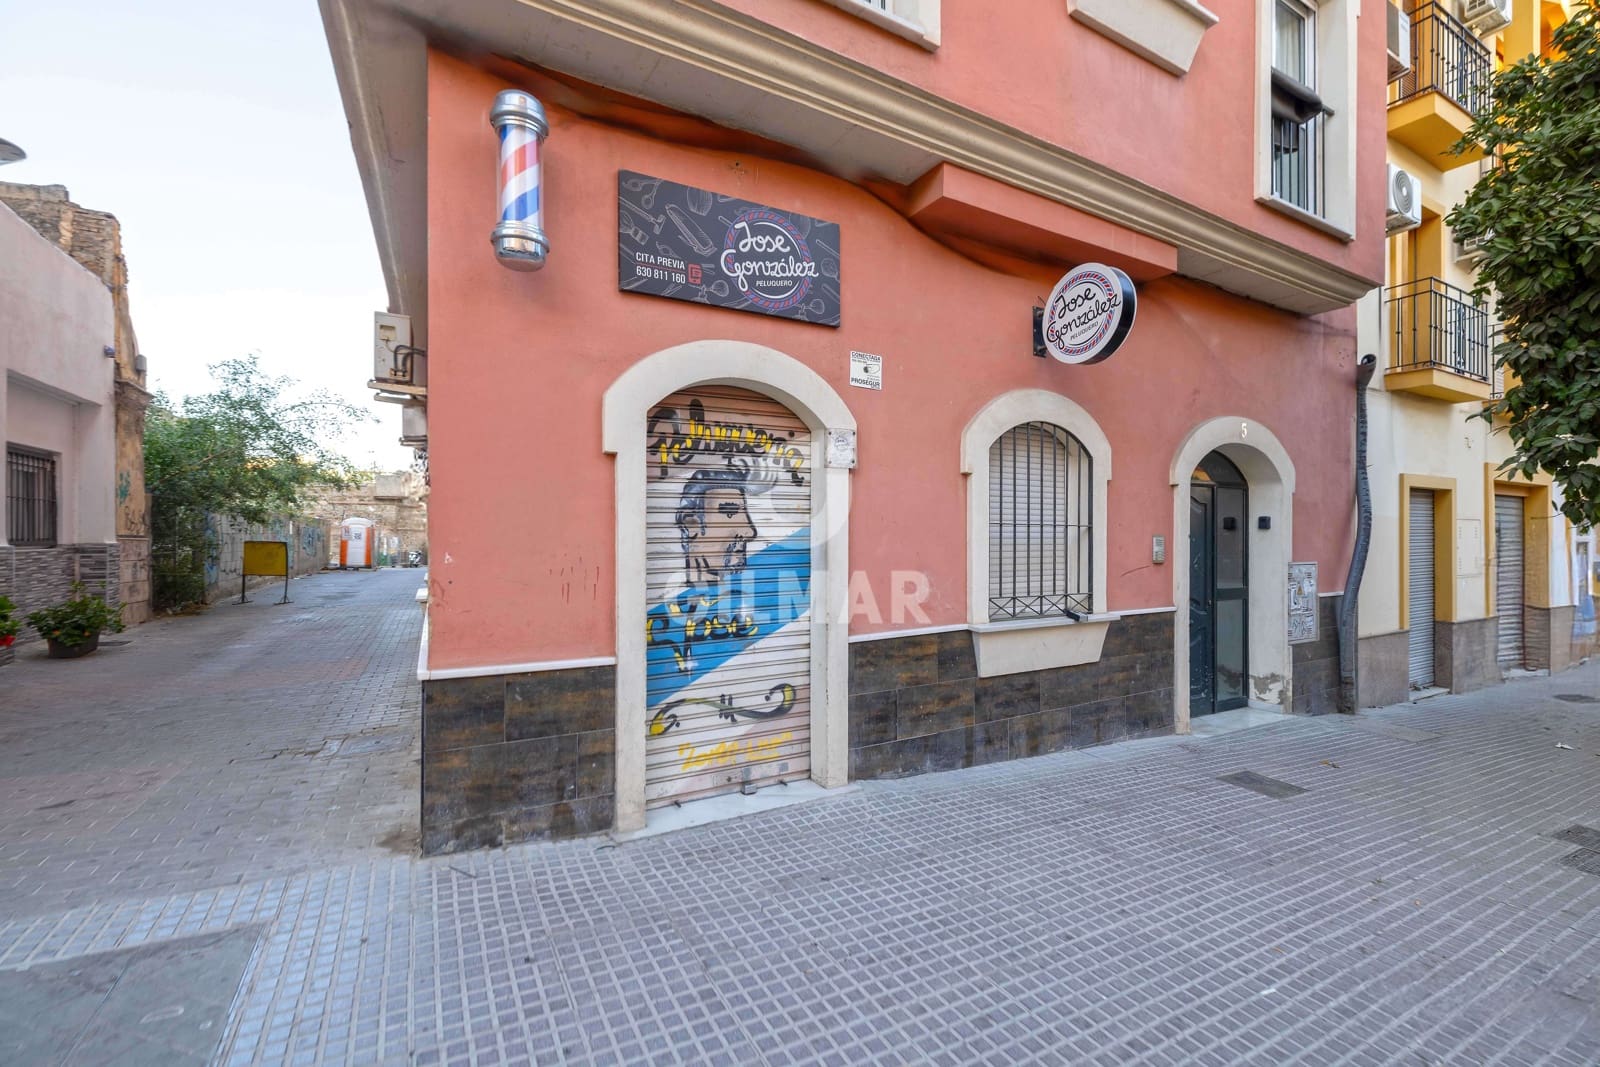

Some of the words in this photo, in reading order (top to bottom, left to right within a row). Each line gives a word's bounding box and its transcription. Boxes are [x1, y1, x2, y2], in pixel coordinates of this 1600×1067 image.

[734, 221, 791, 252] Jose
[636, 252, 655, 264] CITA
[657, 256, 685, 270] PREVIA
[720, 249, 819, 292] González
[636, 266, 652, 278] 630
[653, 269, 668, 281] 811
[671, 272, 686, 284] 160
[755, 279, 793, 287] PELUQUERO
[1055, 287, 1097, 319] Jose
[1046, 293, 1121, 350] González
[1069, 321, 1099, 341] PELUQUERO
[850, 377, 881, 387] PROSEGUR
[1241, 422, 1248, 439] 5
